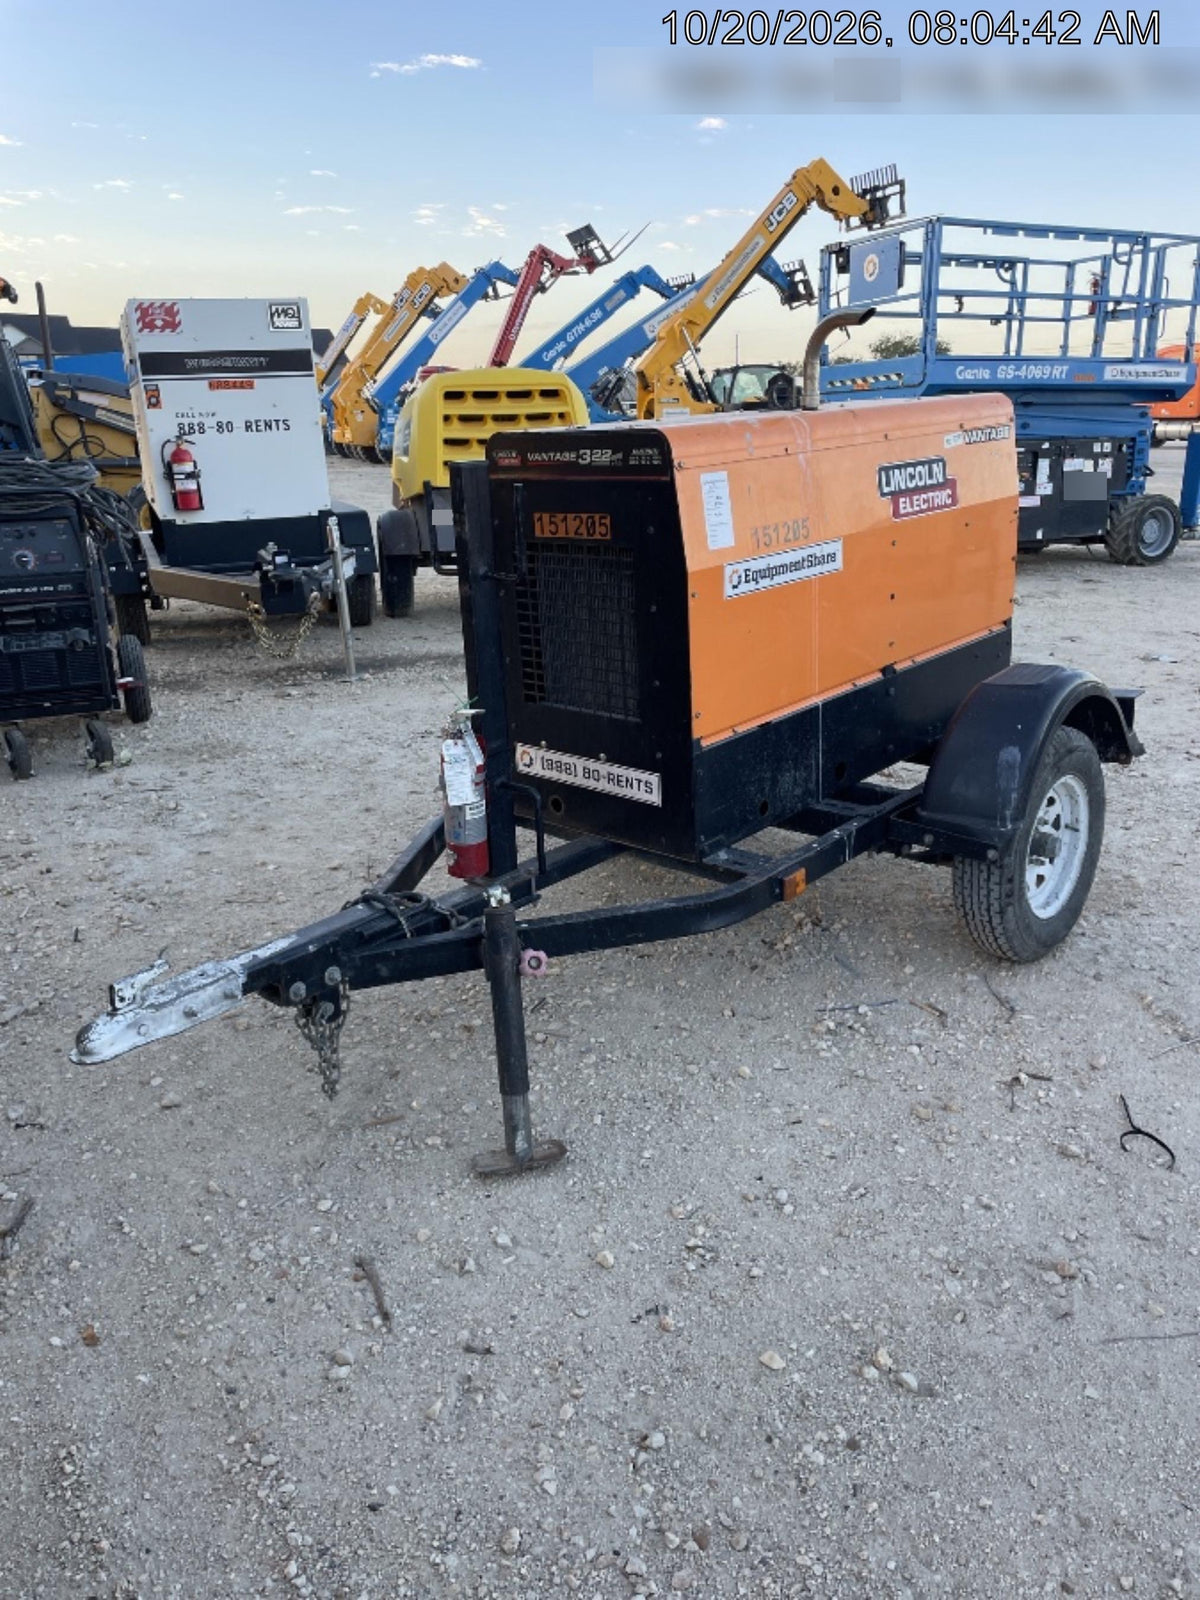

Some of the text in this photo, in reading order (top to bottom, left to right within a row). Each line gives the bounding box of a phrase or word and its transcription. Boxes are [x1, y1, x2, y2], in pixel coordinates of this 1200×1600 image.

[766, 192, 797, 231] JCB
[413, 283, 431, 308] JCB
[955, 365, 991, 380] Genie
[527, 451, 577, 462] VANTAGE
[578, 449, 612, 465] 322
[881, 461, 944, 493] LINCOLN
[899, 489, 952, 514] ELECTRIC
[535, 513, 610, 538] 151205
[752, 518, 811, 549] 151205
[744, 551, 837, 585] EquipmentShare
[541, 755, 577, 778] (888)
